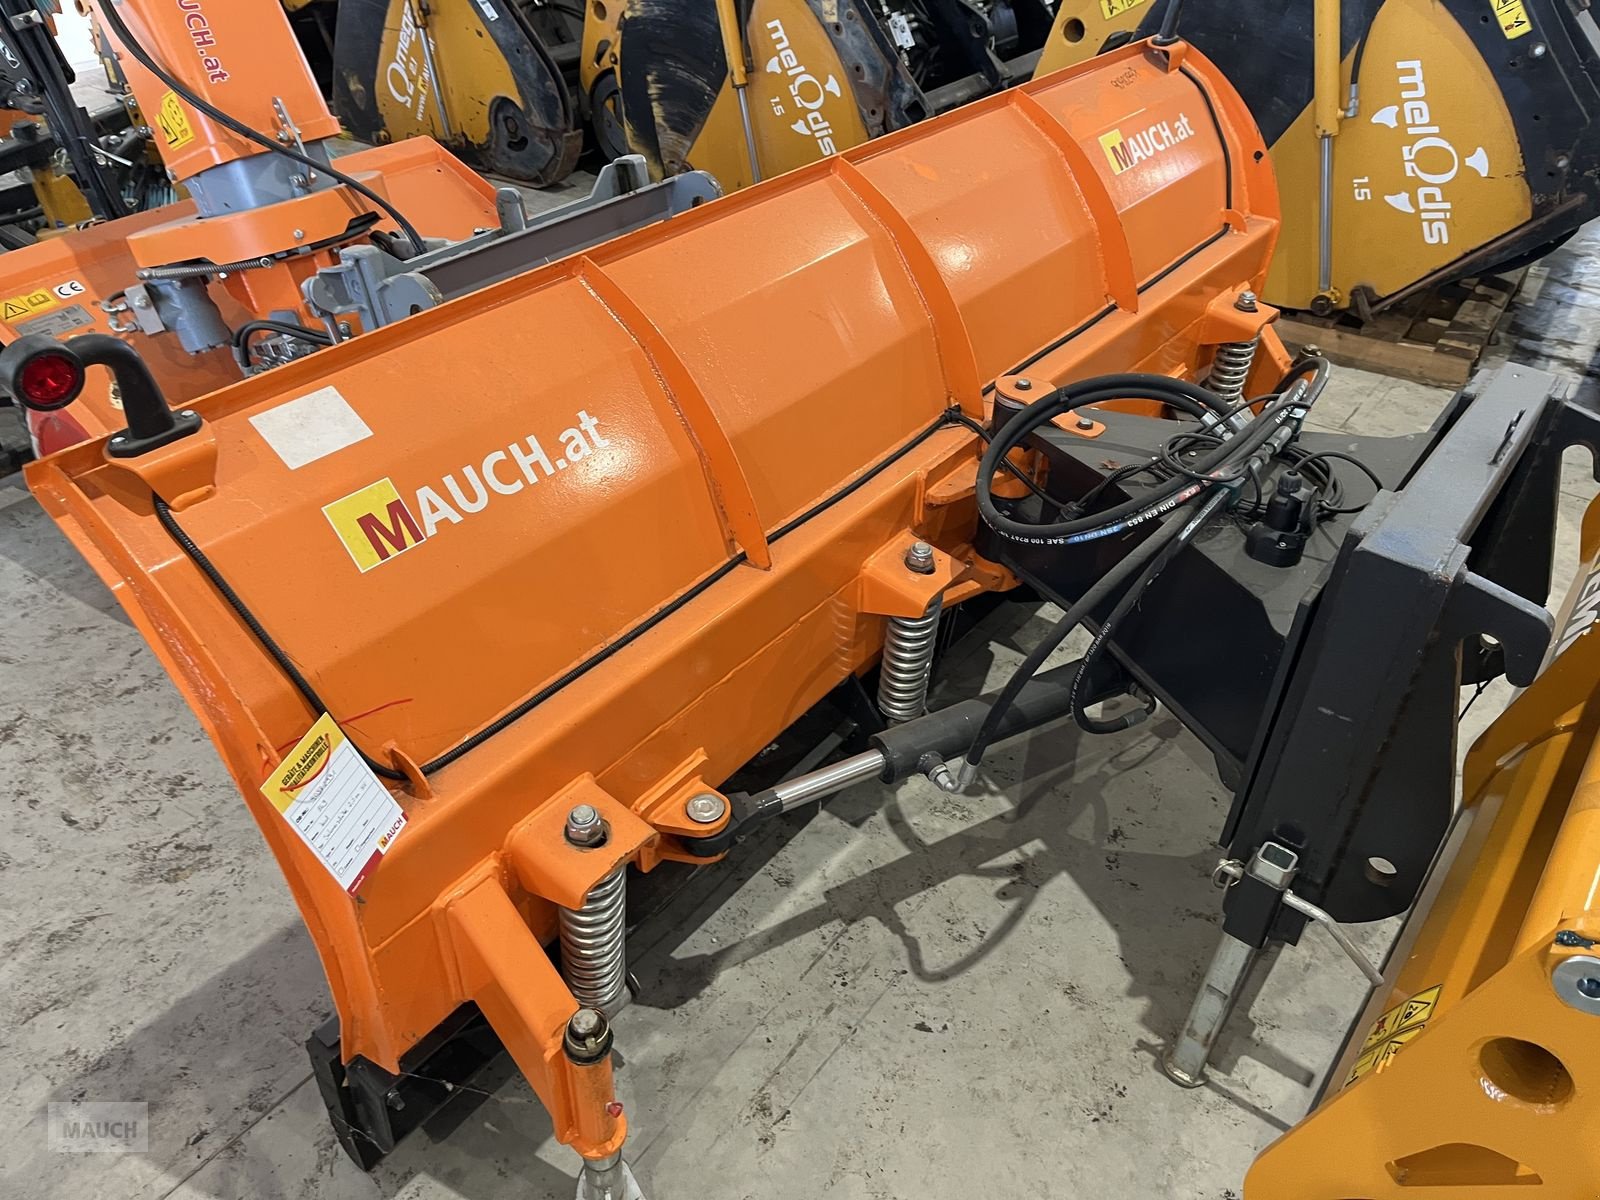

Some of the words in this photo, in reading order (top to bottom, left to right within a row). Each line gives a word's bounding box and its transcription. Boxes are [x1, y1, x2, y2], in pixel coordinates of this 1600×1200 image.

[769, 95, 785, 116] 1.5
[1109, 112, 1195, 171] MAUCH.at
[1353, 176, 1371, 200] 1.5
[355, 409, 610, 562] MAUCH.at
[1145, 509, 1158, 520] EN
[1160, 500, 1176, 513] DIN
[1127, 516, 1144, 527] 853
[1047, 537, 1065, 545] SAE
[281, 766, 300, 786] GERÄTE
[300, 735, 324, 764] MASCHINEN
[380, 817, 404, 848] MAUCH
